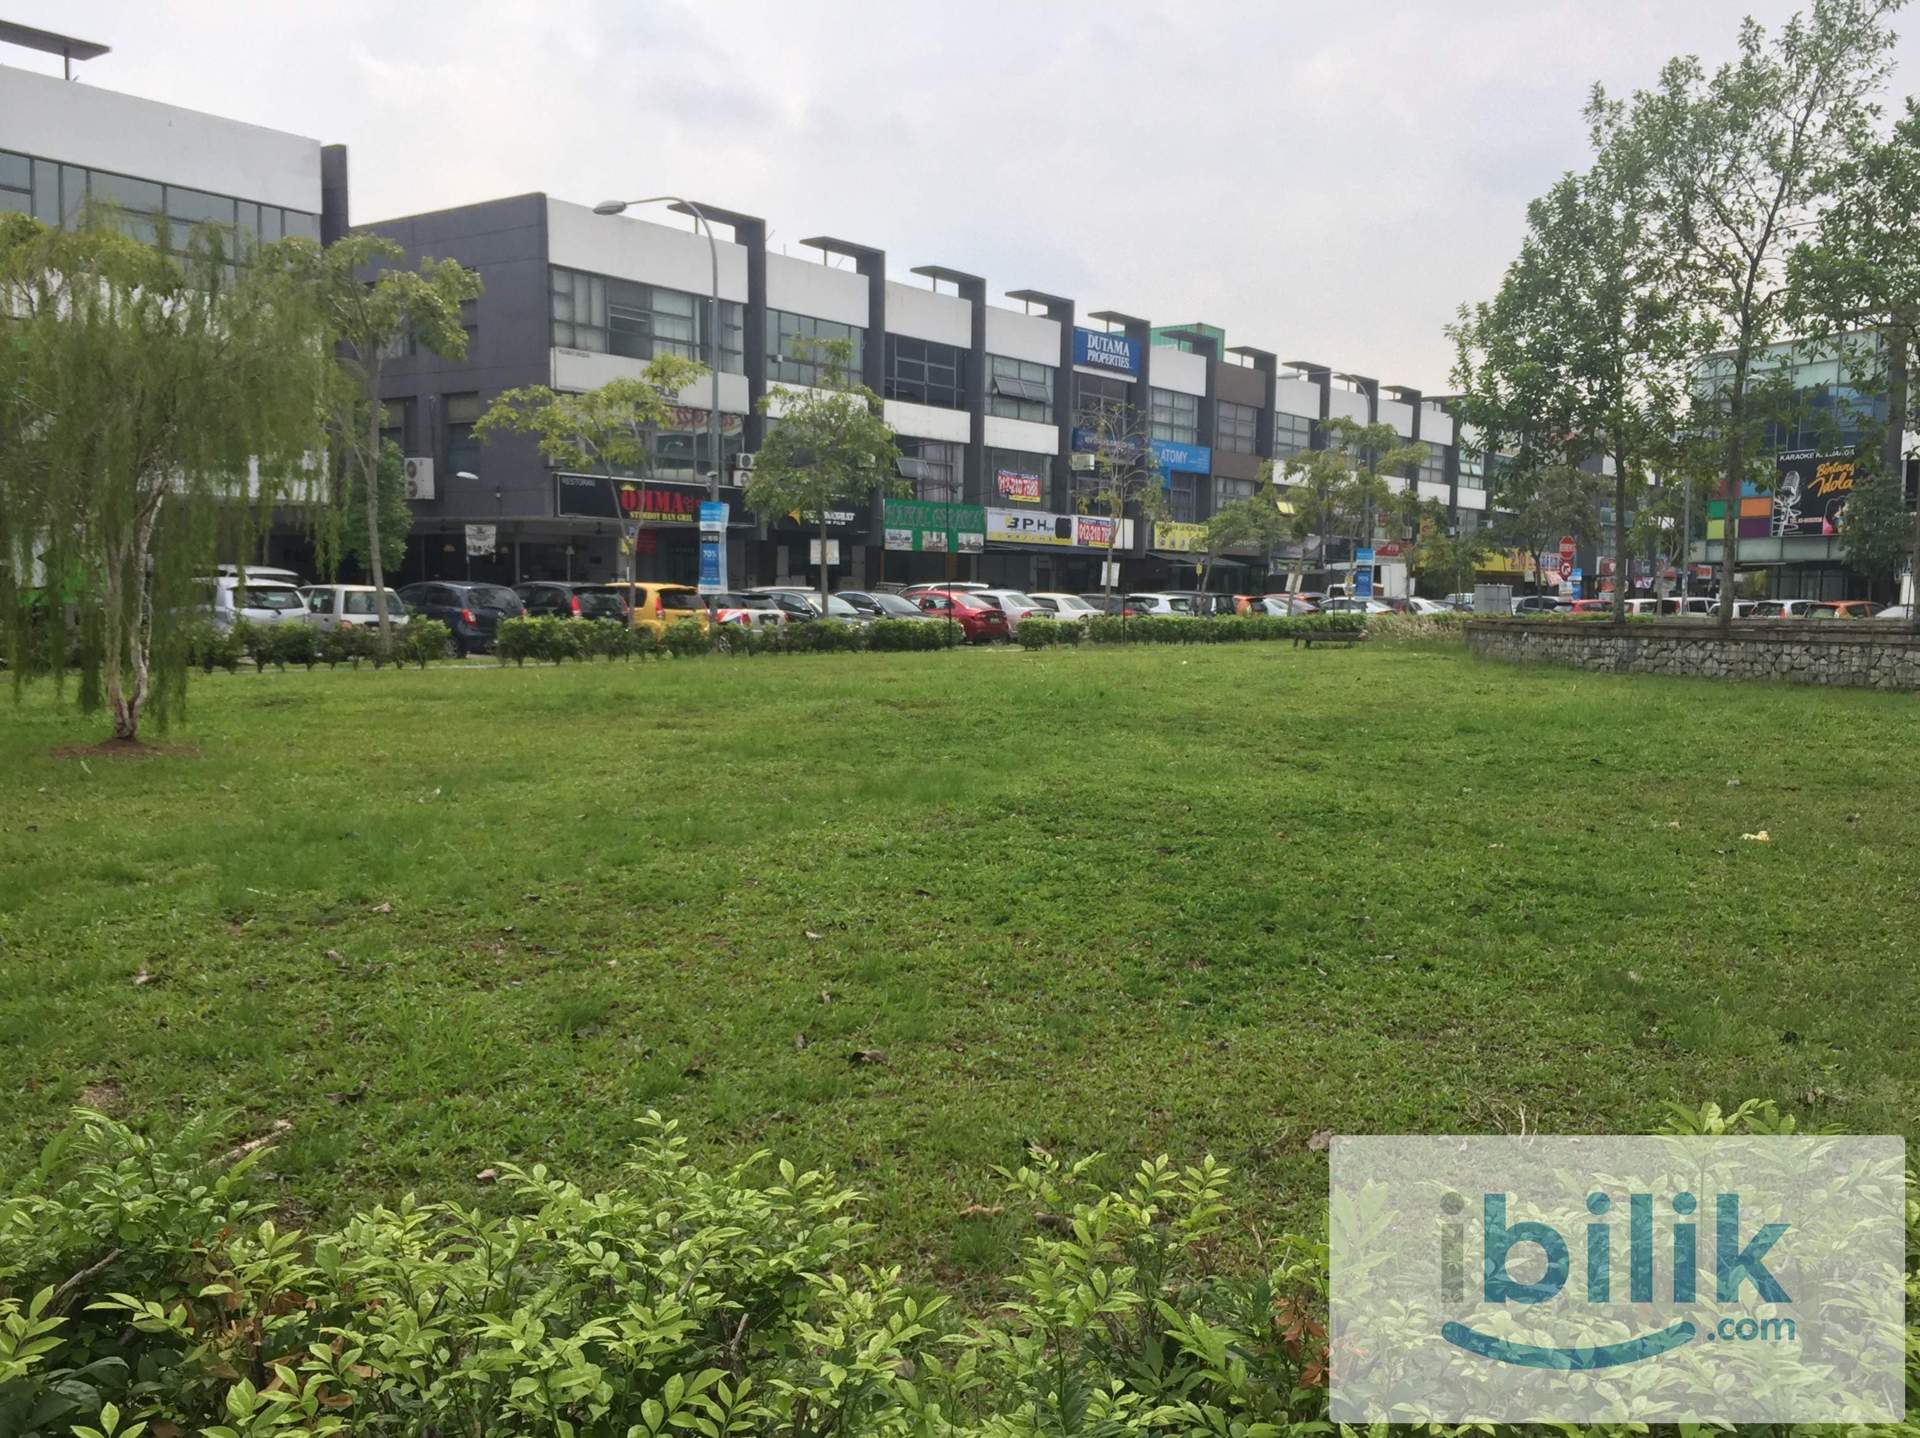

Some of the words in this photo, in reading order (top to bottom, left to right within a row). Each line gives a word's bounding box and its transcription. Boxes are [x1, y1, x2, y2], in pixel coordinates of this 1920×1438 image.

[1087, 349, 1131, 369] PROPERTIES
[1160, 448, 1188, 465] ATOMY
[1780, 452, 1814, 461] KARAOKE
